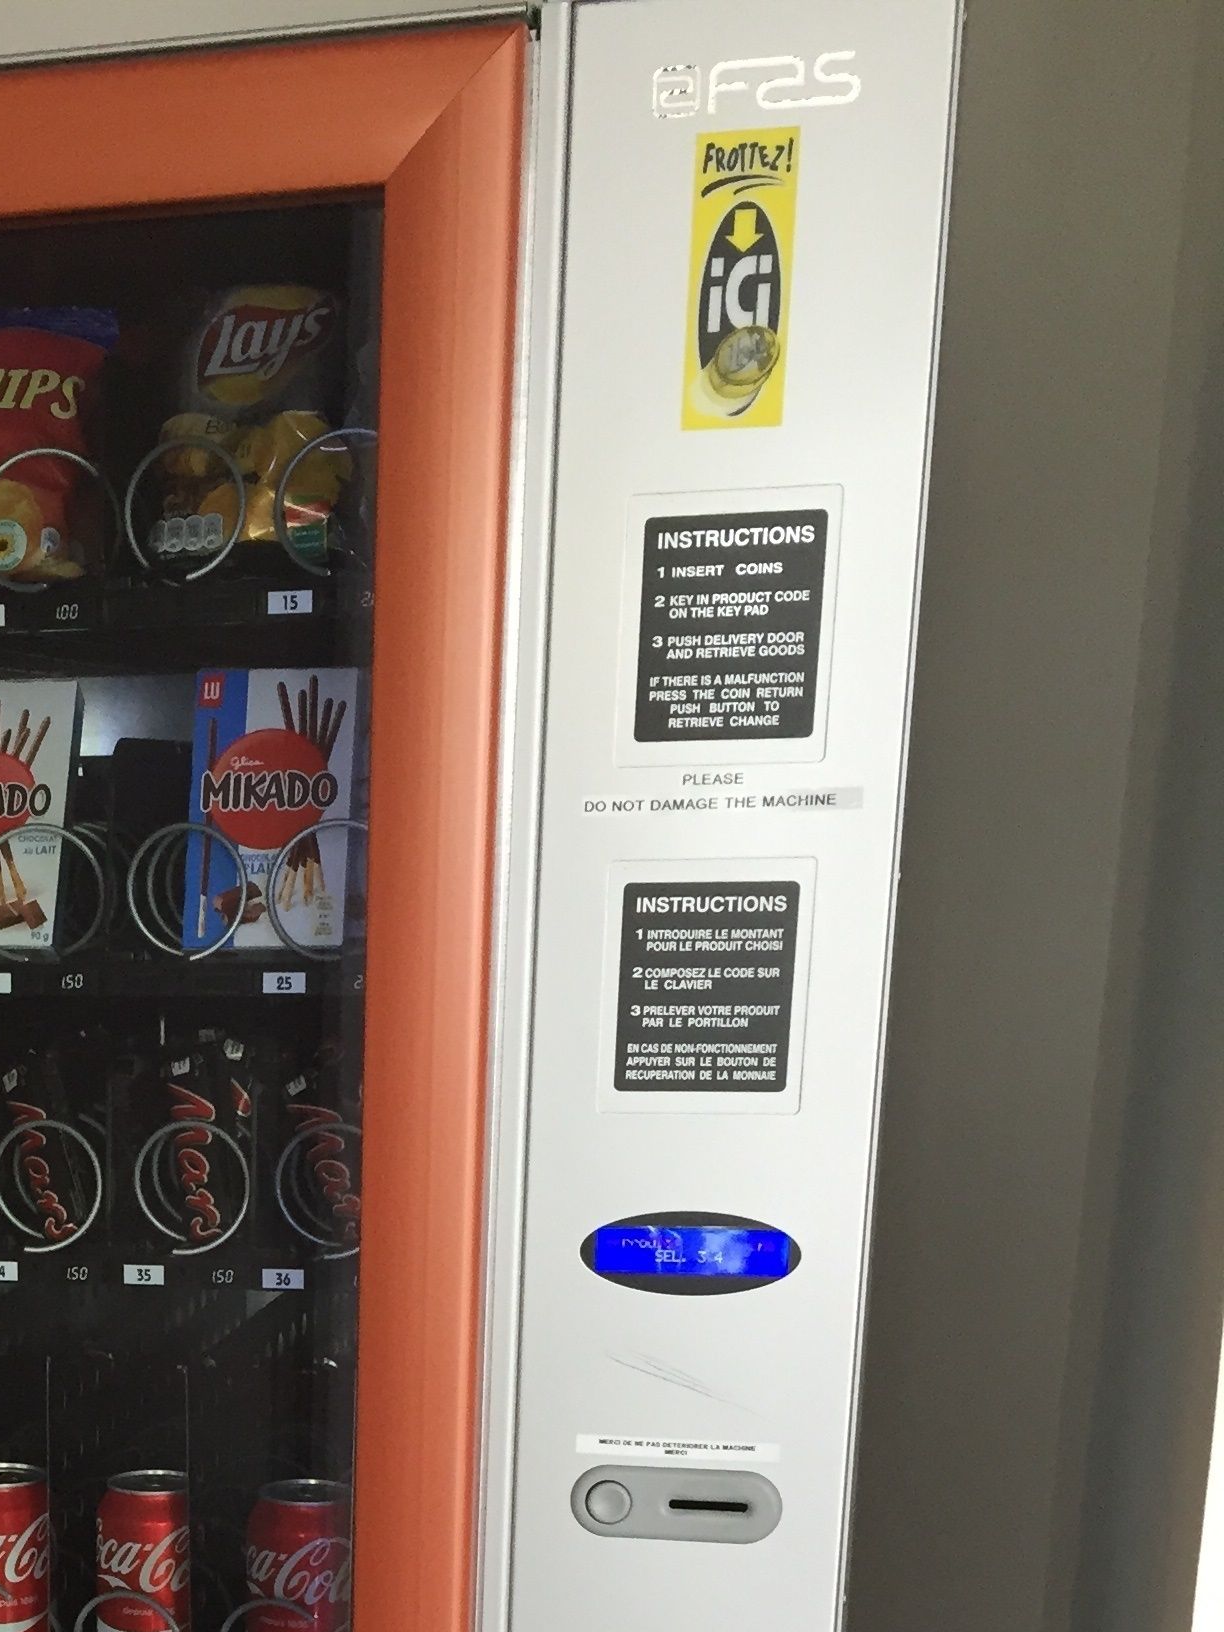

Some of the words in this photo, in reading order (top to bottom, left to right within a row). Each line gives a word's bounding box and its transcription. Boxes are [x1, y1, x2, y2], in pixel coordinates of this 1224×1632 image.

[702, 138, 794, 174] FROTTEZ!
[657, 525, 815, 549] INSTRUCTIONS
[658, 567, 665, 578] 1
[672, 565, 724, 578] INSERT
[736, 562, 783, 575] COINS
[283, 595, 298, 610] 15
[654, 596, 665, 607] 2
[669, 595, 695, 607] KEY
[697, 594, 710, 605] IN
[712, 592, 772, 604] PRODUCT
[775, 591, 810, 602] CODE
[669, 608, 688, 619] ON
[690, 607, 714, 618] THE
[717, 606, 741, 617] KEY
[744, 605, 768, 615] PAD
[652, 636, 663, 648] 3
[668, 636, 701, 647] PUSH
[705, 634, 765, 646] DELIVERY
[767, 632, 804, 643] DOOR
[667, 648, 693, 659] AND
[696, 646, 756, 658] RETRIEVE
[759, 645, 805, 656] GOODS
[650, 677, 660, 687] IF
[662, 675, 697, 687] THERE
[700, 675, 712, 686] IS
[714, 675, 723, 685] A
[724, 672, 805, 685] MALFUNCTION
[649, 691, 687, 701] PRESS
[692, 690, 715, 700] THE
[721, 688, 750, 699] COIN
[756, 687, 803, 698] RETURN
[670, 703, 700, 714] PUSH
[709, 702, 755, 713] BUTTON
[764, 702, 779, 712] TO
[668, 717, 724, 728] RETRIEVE
[730, 715, 780, 726] CHANGE
[682, 773, 744, 786] PLEASE
[200, 770, 338, 812] MIKADO
[584, 801, 608, 813] DO
[611, 801, 645, 812] NOT
[650, 798, 719, 811] DAMAGE
[726, 796, 755, 809] THE
[762, 793, 837, 808] MACHINE
[636, 895, 788, 913] INSTRUCTIONS
[636, 929, 643, 940] 1
[647, 929, 712, 940] INTRODUIRE
[715, 929, 728, 939] LE
[731, 928, 784, 939] MONTANT
[646, 941, 677, 952] POUR
[680, 941, 692, 951] LE
[695, 941, 743, 951] PRODUIT
[745, 940, 783, 951] CHOISI
[632, 967, 642, 978] 2
[645, 967, 706, 978] COMPOSEZ
[708, 968, 721, 978] LE
[724, 967, 754, 978] CODE
[757, 967, 780, 977] SUR
[277, 976, 292, 990] 25
[644, 980, 658, 990] LE
[664, 979, 712, 990] CLAVIER
[630, 1005, 640, 1016] 3
[643, 1005, 695, 1016] PRELEVER
[698, 1006, 732, 1016] VOTRE
[734, 1005, 781, 1016] PRODUIT
[642, 1018, 663, 1028] PAR
[669, 1018, 682, 1028] LE
[688, 1018, 748, 1028] PORTILLON
[627, 1043, 639, 1054] EN
[641, 1043, 659, 1054] CAS
[661, 1044, 672, 1054] DE
[675, 1043, 777, 1054] NON-FONCTIONNEMENT
[626, 1056, 670, 1067] APPUYER
[676, 1057, 695, 1067] SUR
[700, 1057, 712, 1067] LE
[717, 1057, 758, 1067] BOUTON
[763, 1057, 776, 1067] DE
[626, 1070, 695, 1080] RECUPERATION
[700, 1070, 712, 1080] DE
[717, 1070, 728, 1080] LA
[733, 1070, 776, 1080] MONNAIE
[136, 1268, 151, 1283] 35
[275, 1272, 291, 1287] 36
[663, 1442, 708, 1450] DETERIORER
